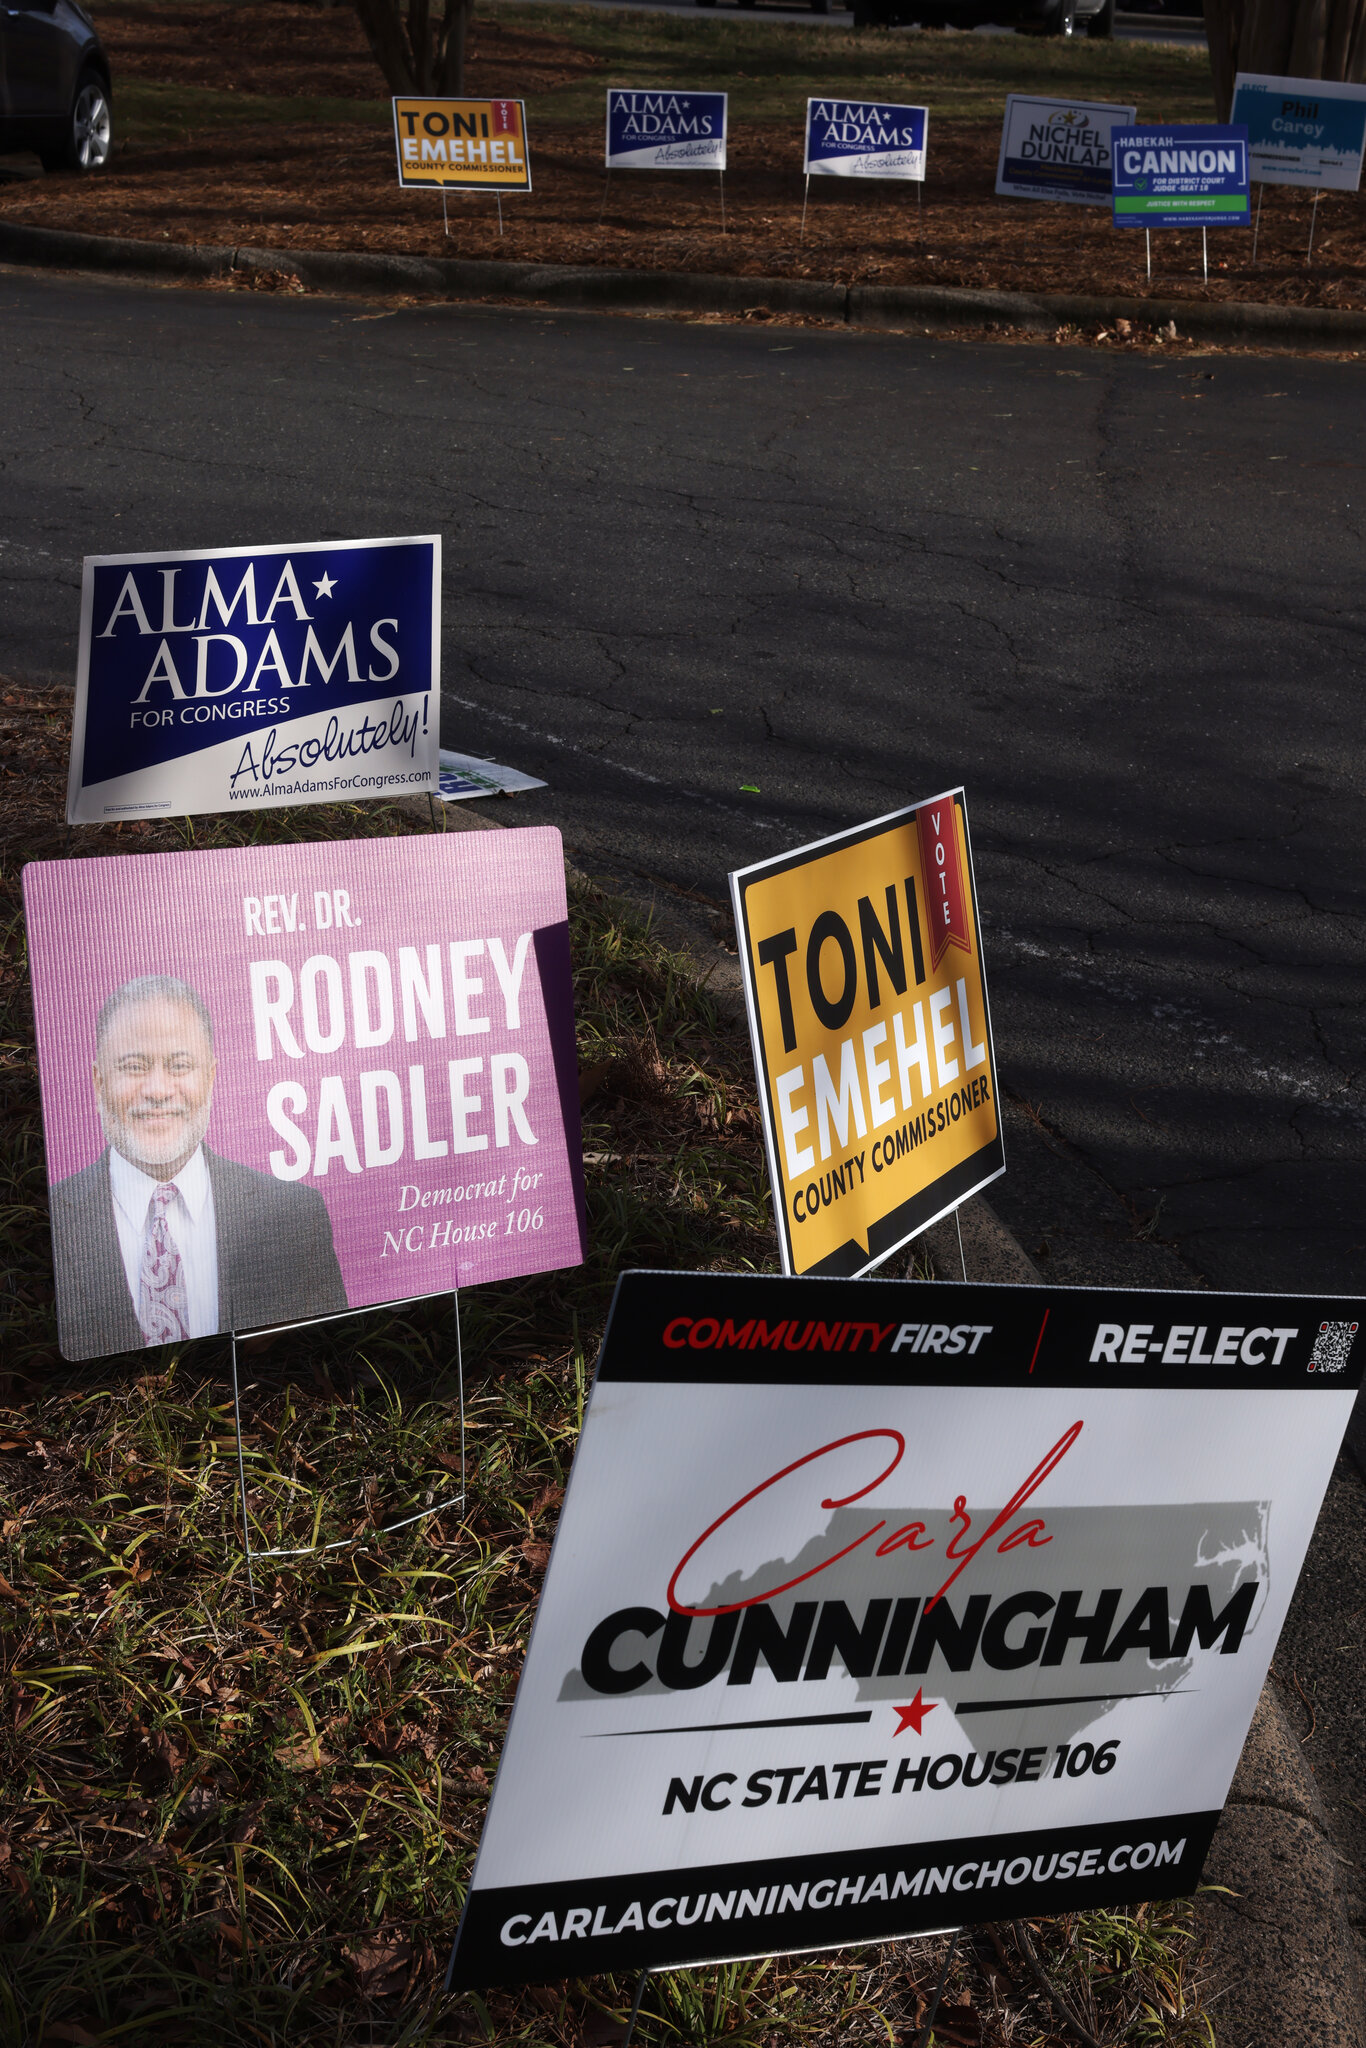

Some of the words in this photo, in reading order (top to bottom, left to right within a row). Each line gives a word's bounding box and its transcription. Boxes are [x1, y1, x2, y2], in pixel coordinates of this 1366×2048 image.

[500, 102, 508, 129] VOTE
[612, 94, 682, 114] ALMA
[812, 102, 883, 126] ALMA
[1281, 101, 1320, 119] Phil
[400, 112, 489, 137] TONI
[624, 114, 712, 135] ADAMS
[822, 122, 913, 146] ADAMS
[1030, 124, 1104, 148] NICHEL
[1272, 118, 1325, 139] Carey
[403, 138, 523, 164] EMEHEL
[654, 140, 722, 161] Absolutely!
[837, 142, 876, 151] CONGRESS
[1021, 141, 1109, 166] DUNLAP
[1120, 137, 1173, 147] HABEKAH
[405, 162, 445, 170] COUNTY
[448, 163, 524, 173] COMMISSIONER
[854, 152, 922, 169] Absolutely!
[1123, 150, 1236, 174] CANNON
[95, 559, 315, 638] ALMA
[130, 618, 400, 704] ADAMS
[130, 710, 174, 729] FOR
[180, 697, 290, 724] CONGRESS
[230, 694, 429, 789] Absolutely!
[228, 770, 432, 800] www.AlmaAdamsForCongress.com
[931, 812, 951, 926] VOTE
[243, 892, 306, 937] REV.
[313, 889, 362, 930] DR.
[757, 876, 926, 1054] TONI
[248, 931, 535, 1062] RODNEY
[775, 976, 986, 1182] EMEHEL
[264, 1052, 540, 1182] SADLER
[792, 1150, 866, 1224] COUNTY
[872, 1074, 991, 1174] COMMISSIONER
[398, 1174, 507, 1213] Democrat
[508, 1168, 544, 1196] for
[380, 1228, 424, 1259] NC
[428, 1218, 497, 1250] House
[503, 1206, 545, 1236] 106
[1088, 1322, 1300, 1366] RE-ELECT
[666, 1419, 1086, 1617] Carla
[580, 1581, 1262, 1695] CUNNINGHAM
[662, 1772, 738, 1817] NC
[740, 1758, 888, 1807] STATE
[890, 1744, 1046, 1795] HOUSE
[1052, 1740, 1121, 1780] 106
[498, 1838, 1188, 1948] CARLACUNNINGHAMNCHOUSE.COM
